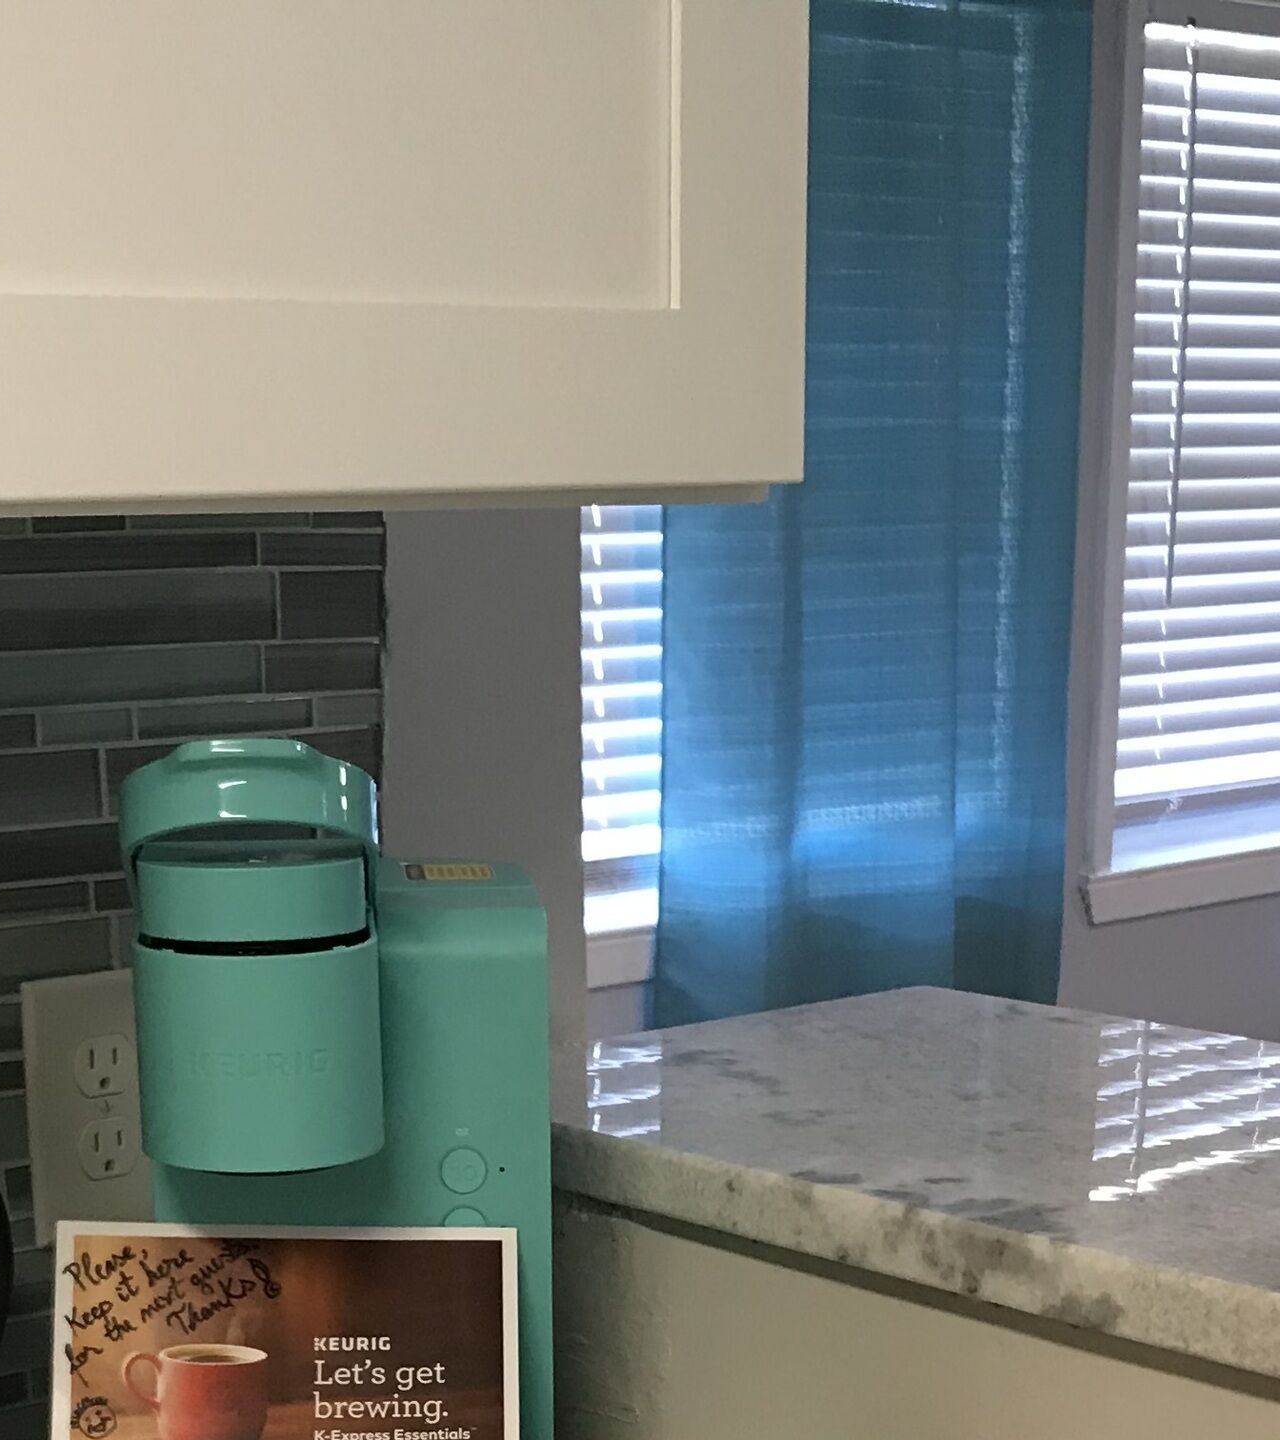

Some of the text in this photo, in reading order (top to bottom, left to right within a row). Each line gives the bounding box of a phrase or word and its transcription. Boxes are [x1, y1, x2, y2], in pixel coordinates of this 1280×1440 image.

[188, 1048, 332, 1079] KEURIG
[64, 1300, 114, 1336] Keep
[116, 1270, 140, 1303] it
[103, 1315, 138, 1342] the
[313, 1336, 391, 1352] KEURIG
[313, 1359, 446, 1391] Let's get
[313, 1391, 449, 1425] brewing.
